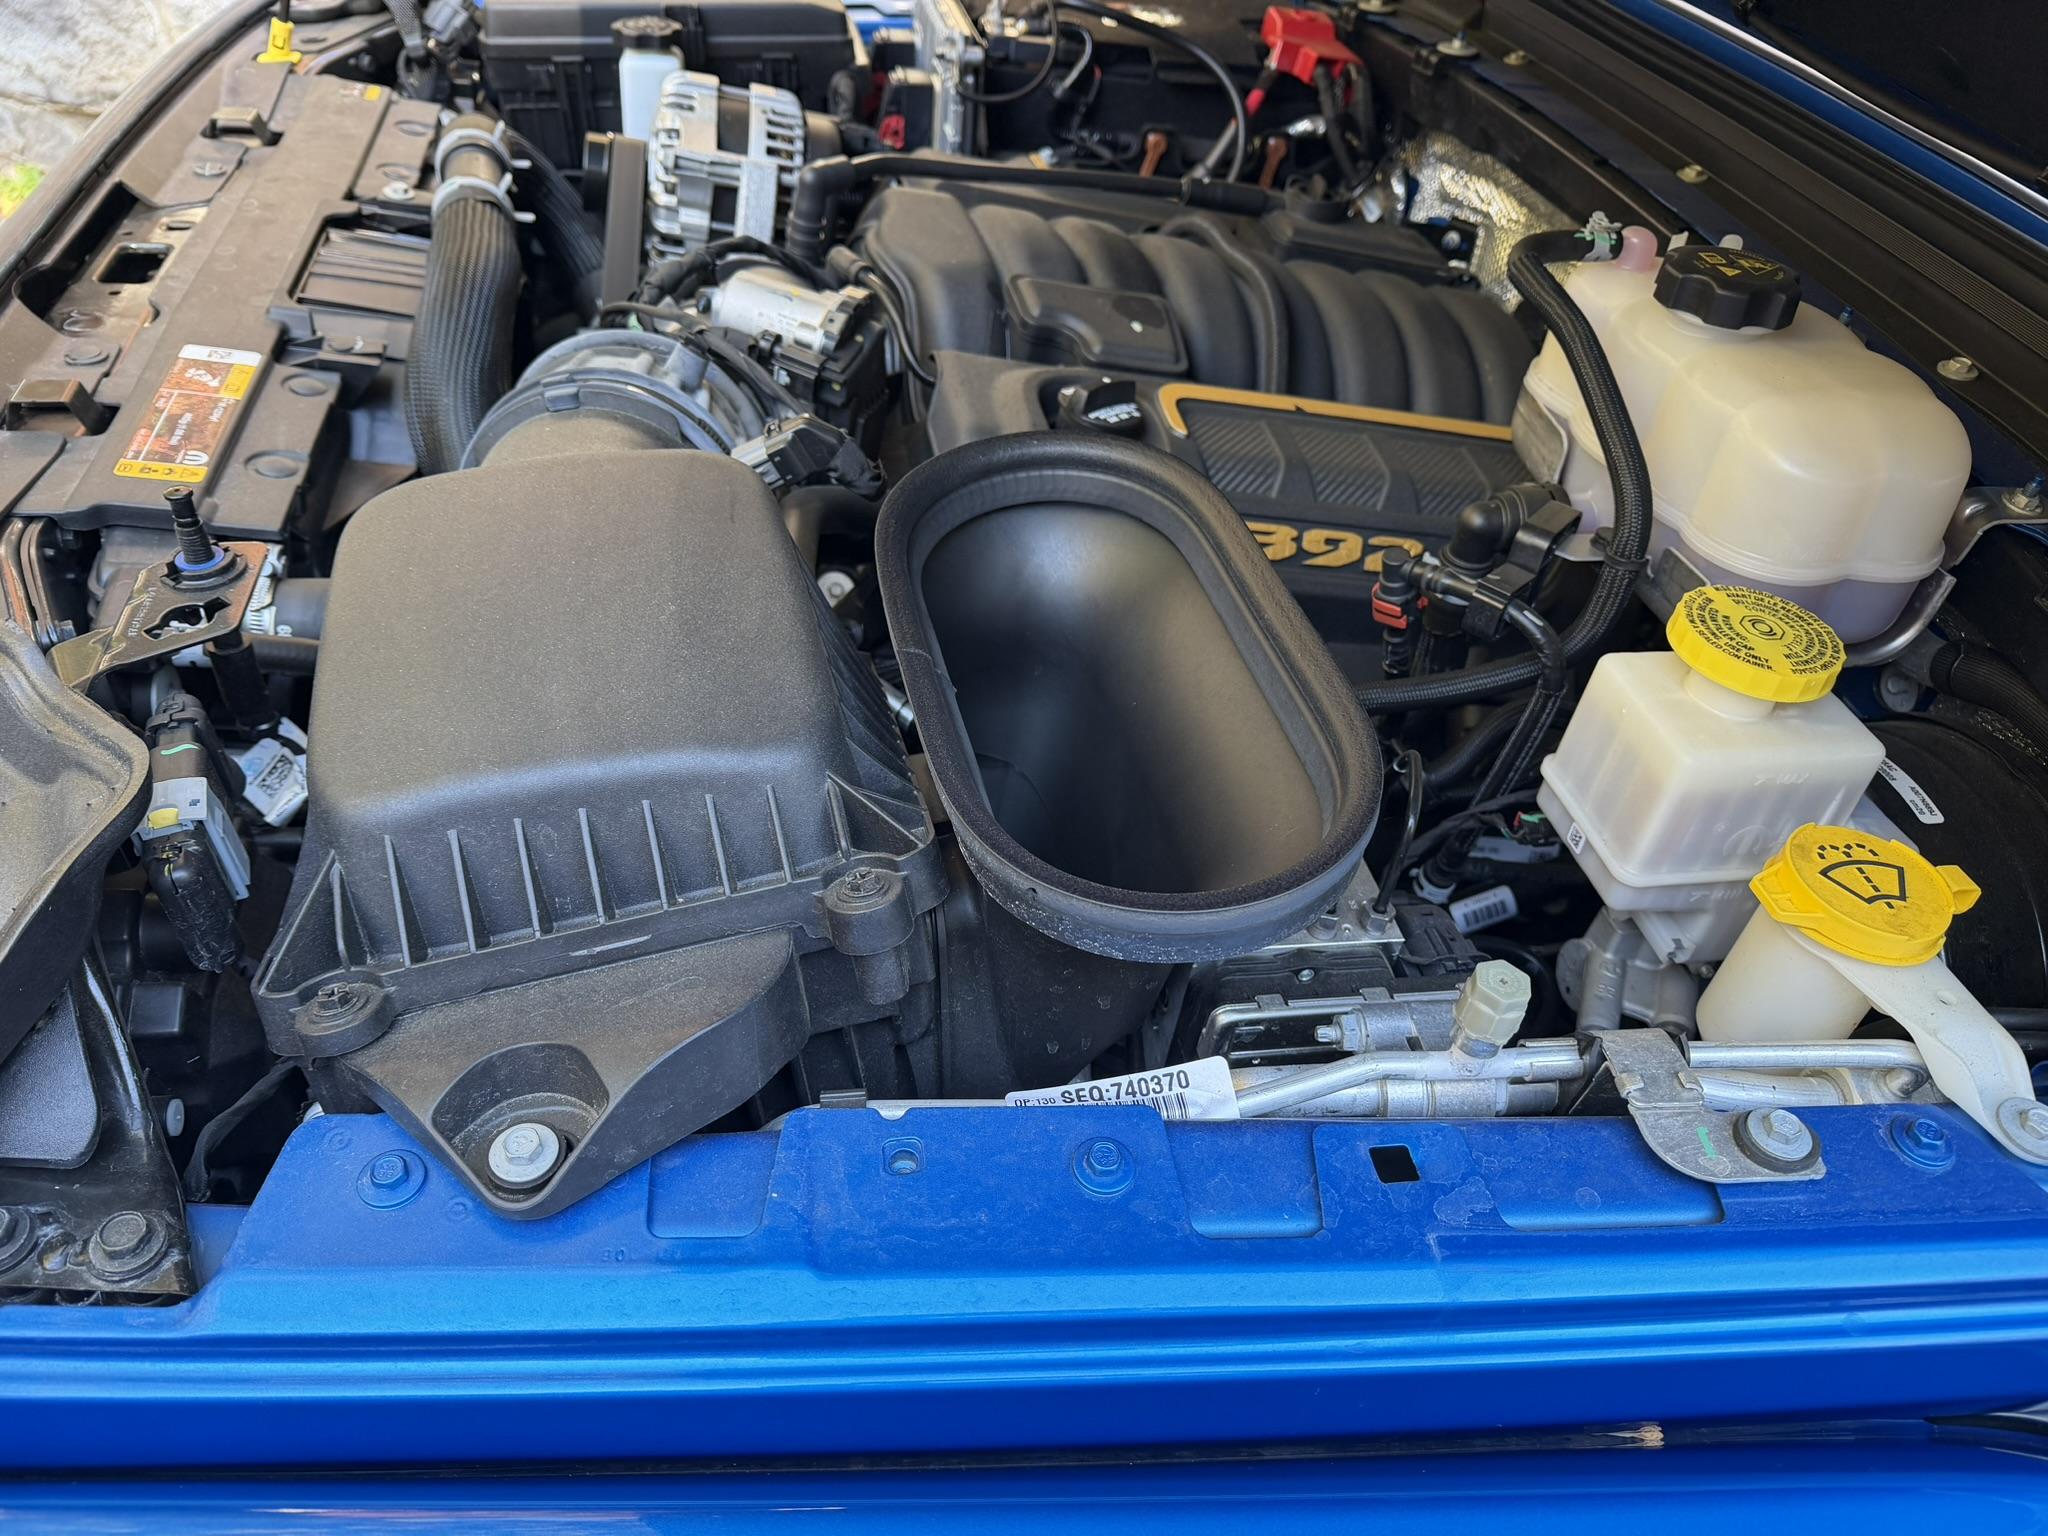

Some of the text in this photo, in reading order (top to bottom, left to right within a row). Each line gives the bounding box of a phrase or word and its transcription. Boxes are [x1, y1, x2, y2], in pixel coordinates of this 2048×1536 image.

[1724, 642, 1742, 653] USE
[1744, 652, 1768, 663] ONLY
[1736, 641, 1755, 651] CAP
[1060, 1069, 1190, 1104] SEQ:740370
